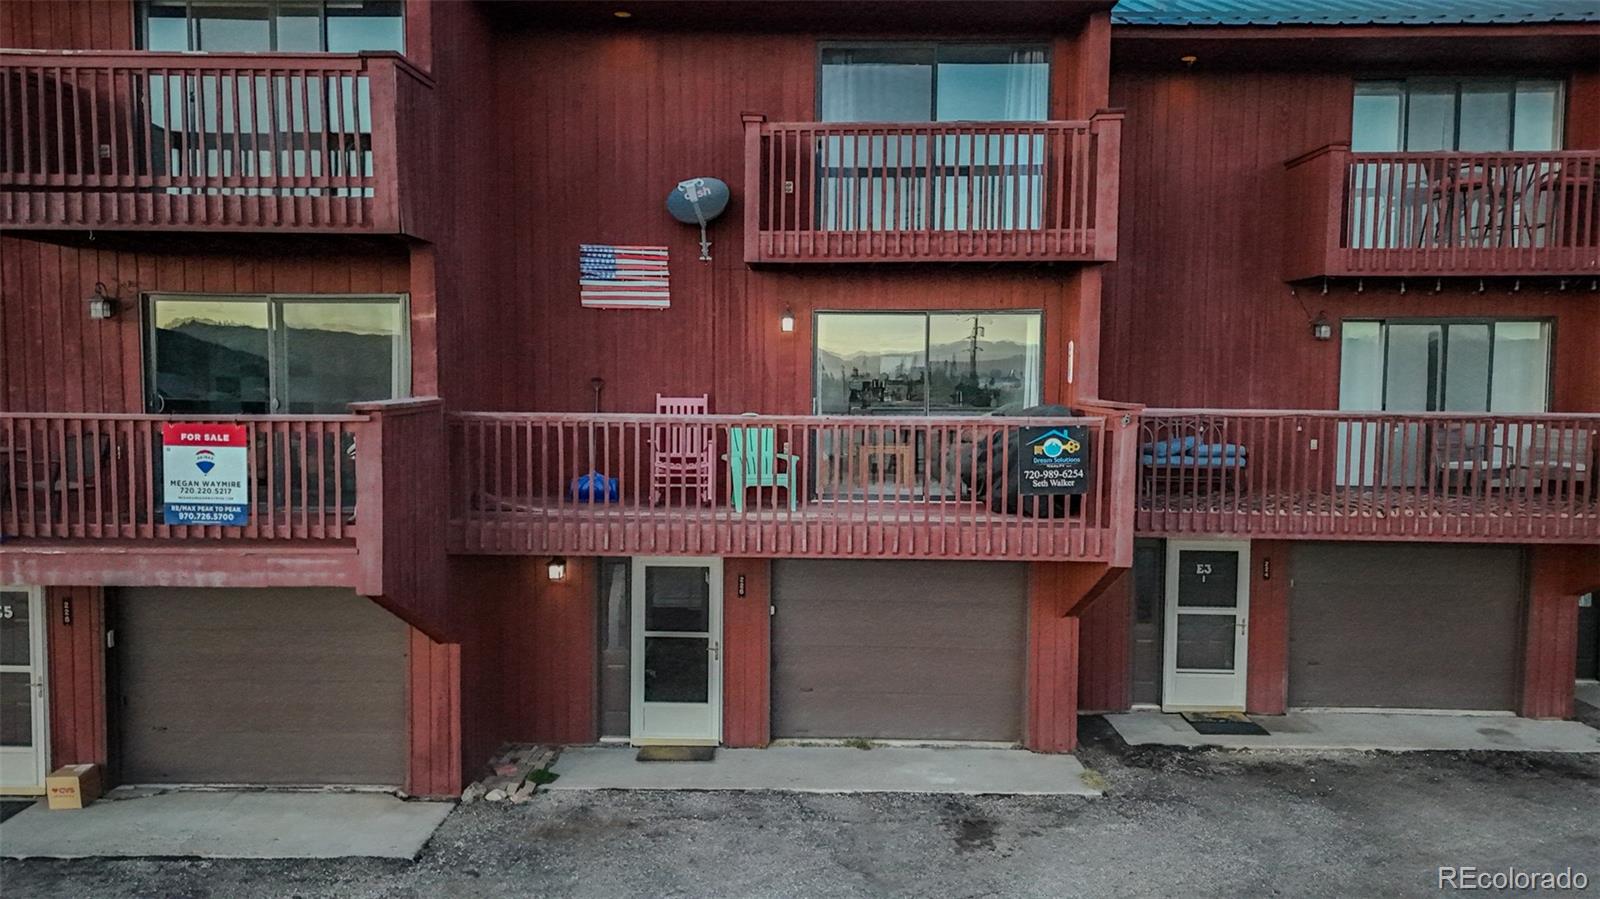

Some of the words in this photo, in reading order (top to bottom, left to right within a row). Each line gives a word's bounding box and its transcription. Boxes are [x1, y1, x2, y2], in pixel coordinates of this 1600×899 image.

[181, 433, 201, 441] FOR
[204, 434, 230, 442] SALE
[1023, 469, 1084, 479] 720-989-6254
[1032, 479, 1048, 487] Seth
[1050, 479, 1075, 487] Walker
[1196, 564, 1212, 574] E3
